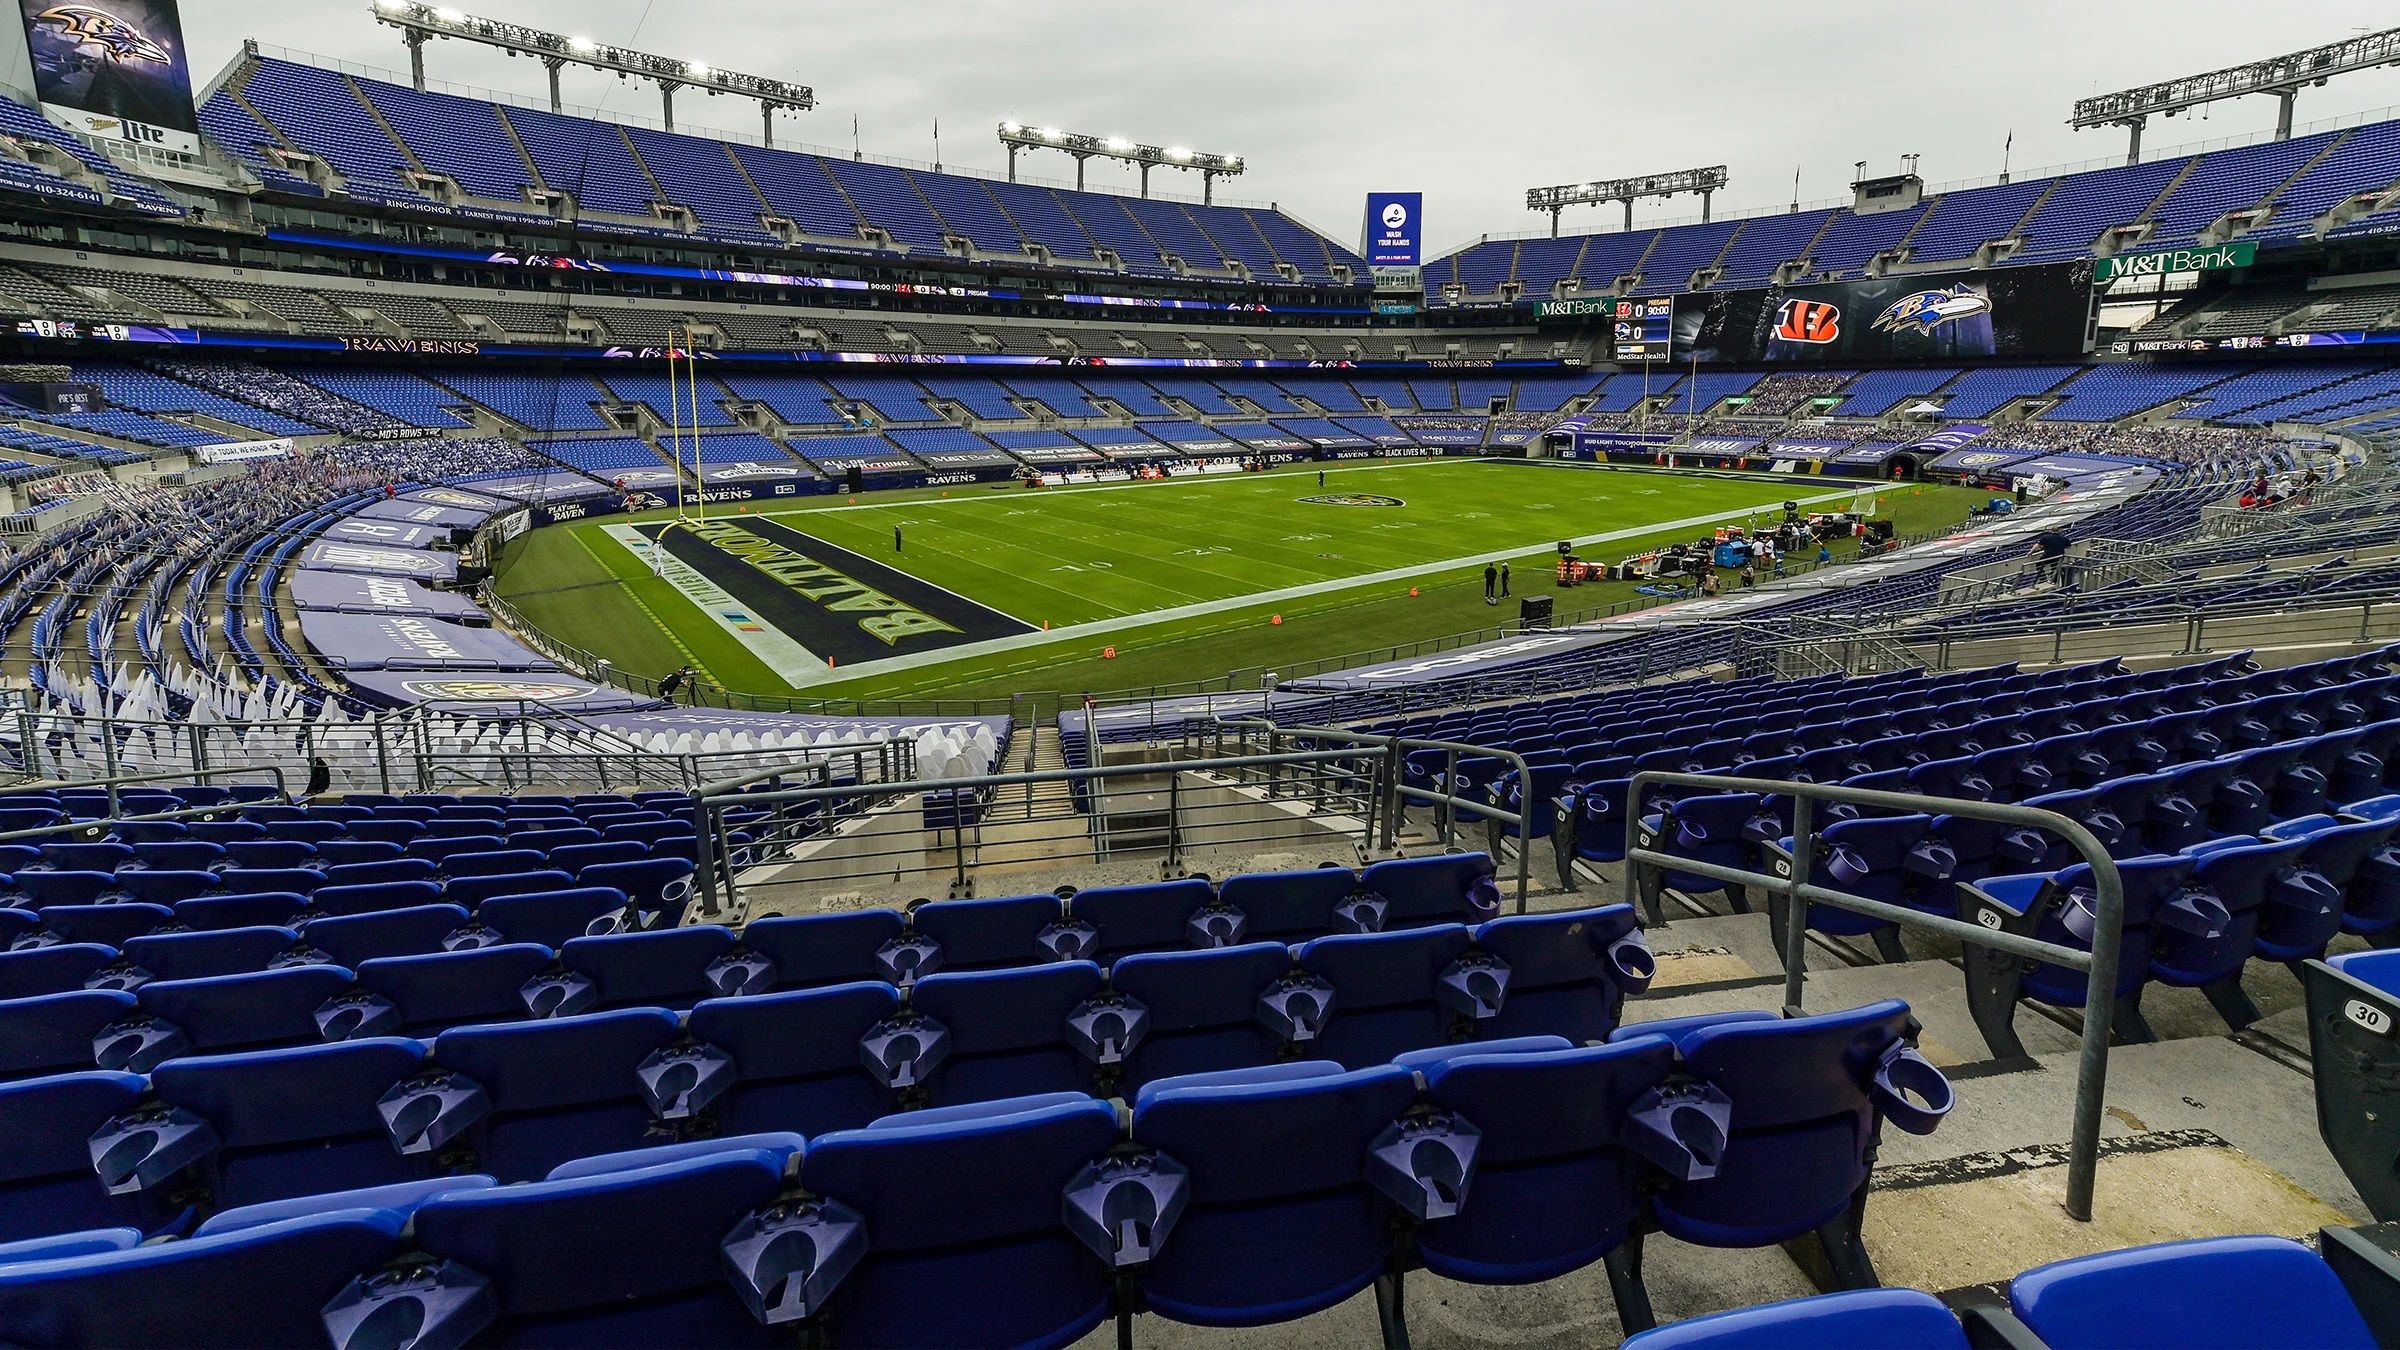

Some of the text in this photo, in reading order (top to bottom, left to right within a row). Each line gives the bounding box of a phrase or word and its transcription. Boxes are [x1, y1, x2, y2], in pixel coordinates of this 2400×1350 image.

[119, 118, 165, 143] Lite
[34, 183, 101, 203] 410-324-6141
[136, 202, 181, 216] RAVENS
[387, 199, 410, 210] RING
[416, 203, 452, 215] HONOR
[465, 210, 494, 220] EARNEST
[496, 213, 518, 224] BYNER
[663, 232, 683, 241] ARTHUR
[721, 237, 742, 246] MICHAEL
[2109, 247, 2237, 278] M&T Bank
[870, 283, 891, 291] 90:00
[968, 289, 989, 297] PREGAME
[1541, 299, 1608, 316] M&T Bank
[1635, 304, 1644, 318] 0
[1648, 306, 1670, 316] 90:00
[1634, 326, 1642, 340] 0
[339, 336, 479, 354] RAVENS
[2162, 341, 2186, 350] Bank
[378, 427, 422, 440] MO'S ROWS
[240, 446, 250, 454] WE
[1385, 448, 1444, 457] BLACK LIVES MATER
[1775, 444, 1832, 454] VISA
[926, 474, 977, 485] RAVENS
[683, 488, 752, 504] RAVENS
[548, 504, 566, 514] PLAY
[553, 508, 586, 521] RAVEN
[1049, 561, 1114, 573] 10
[1983, 912, 1996, 926] 29
[2355, 1006, 2379, 1026] 30
